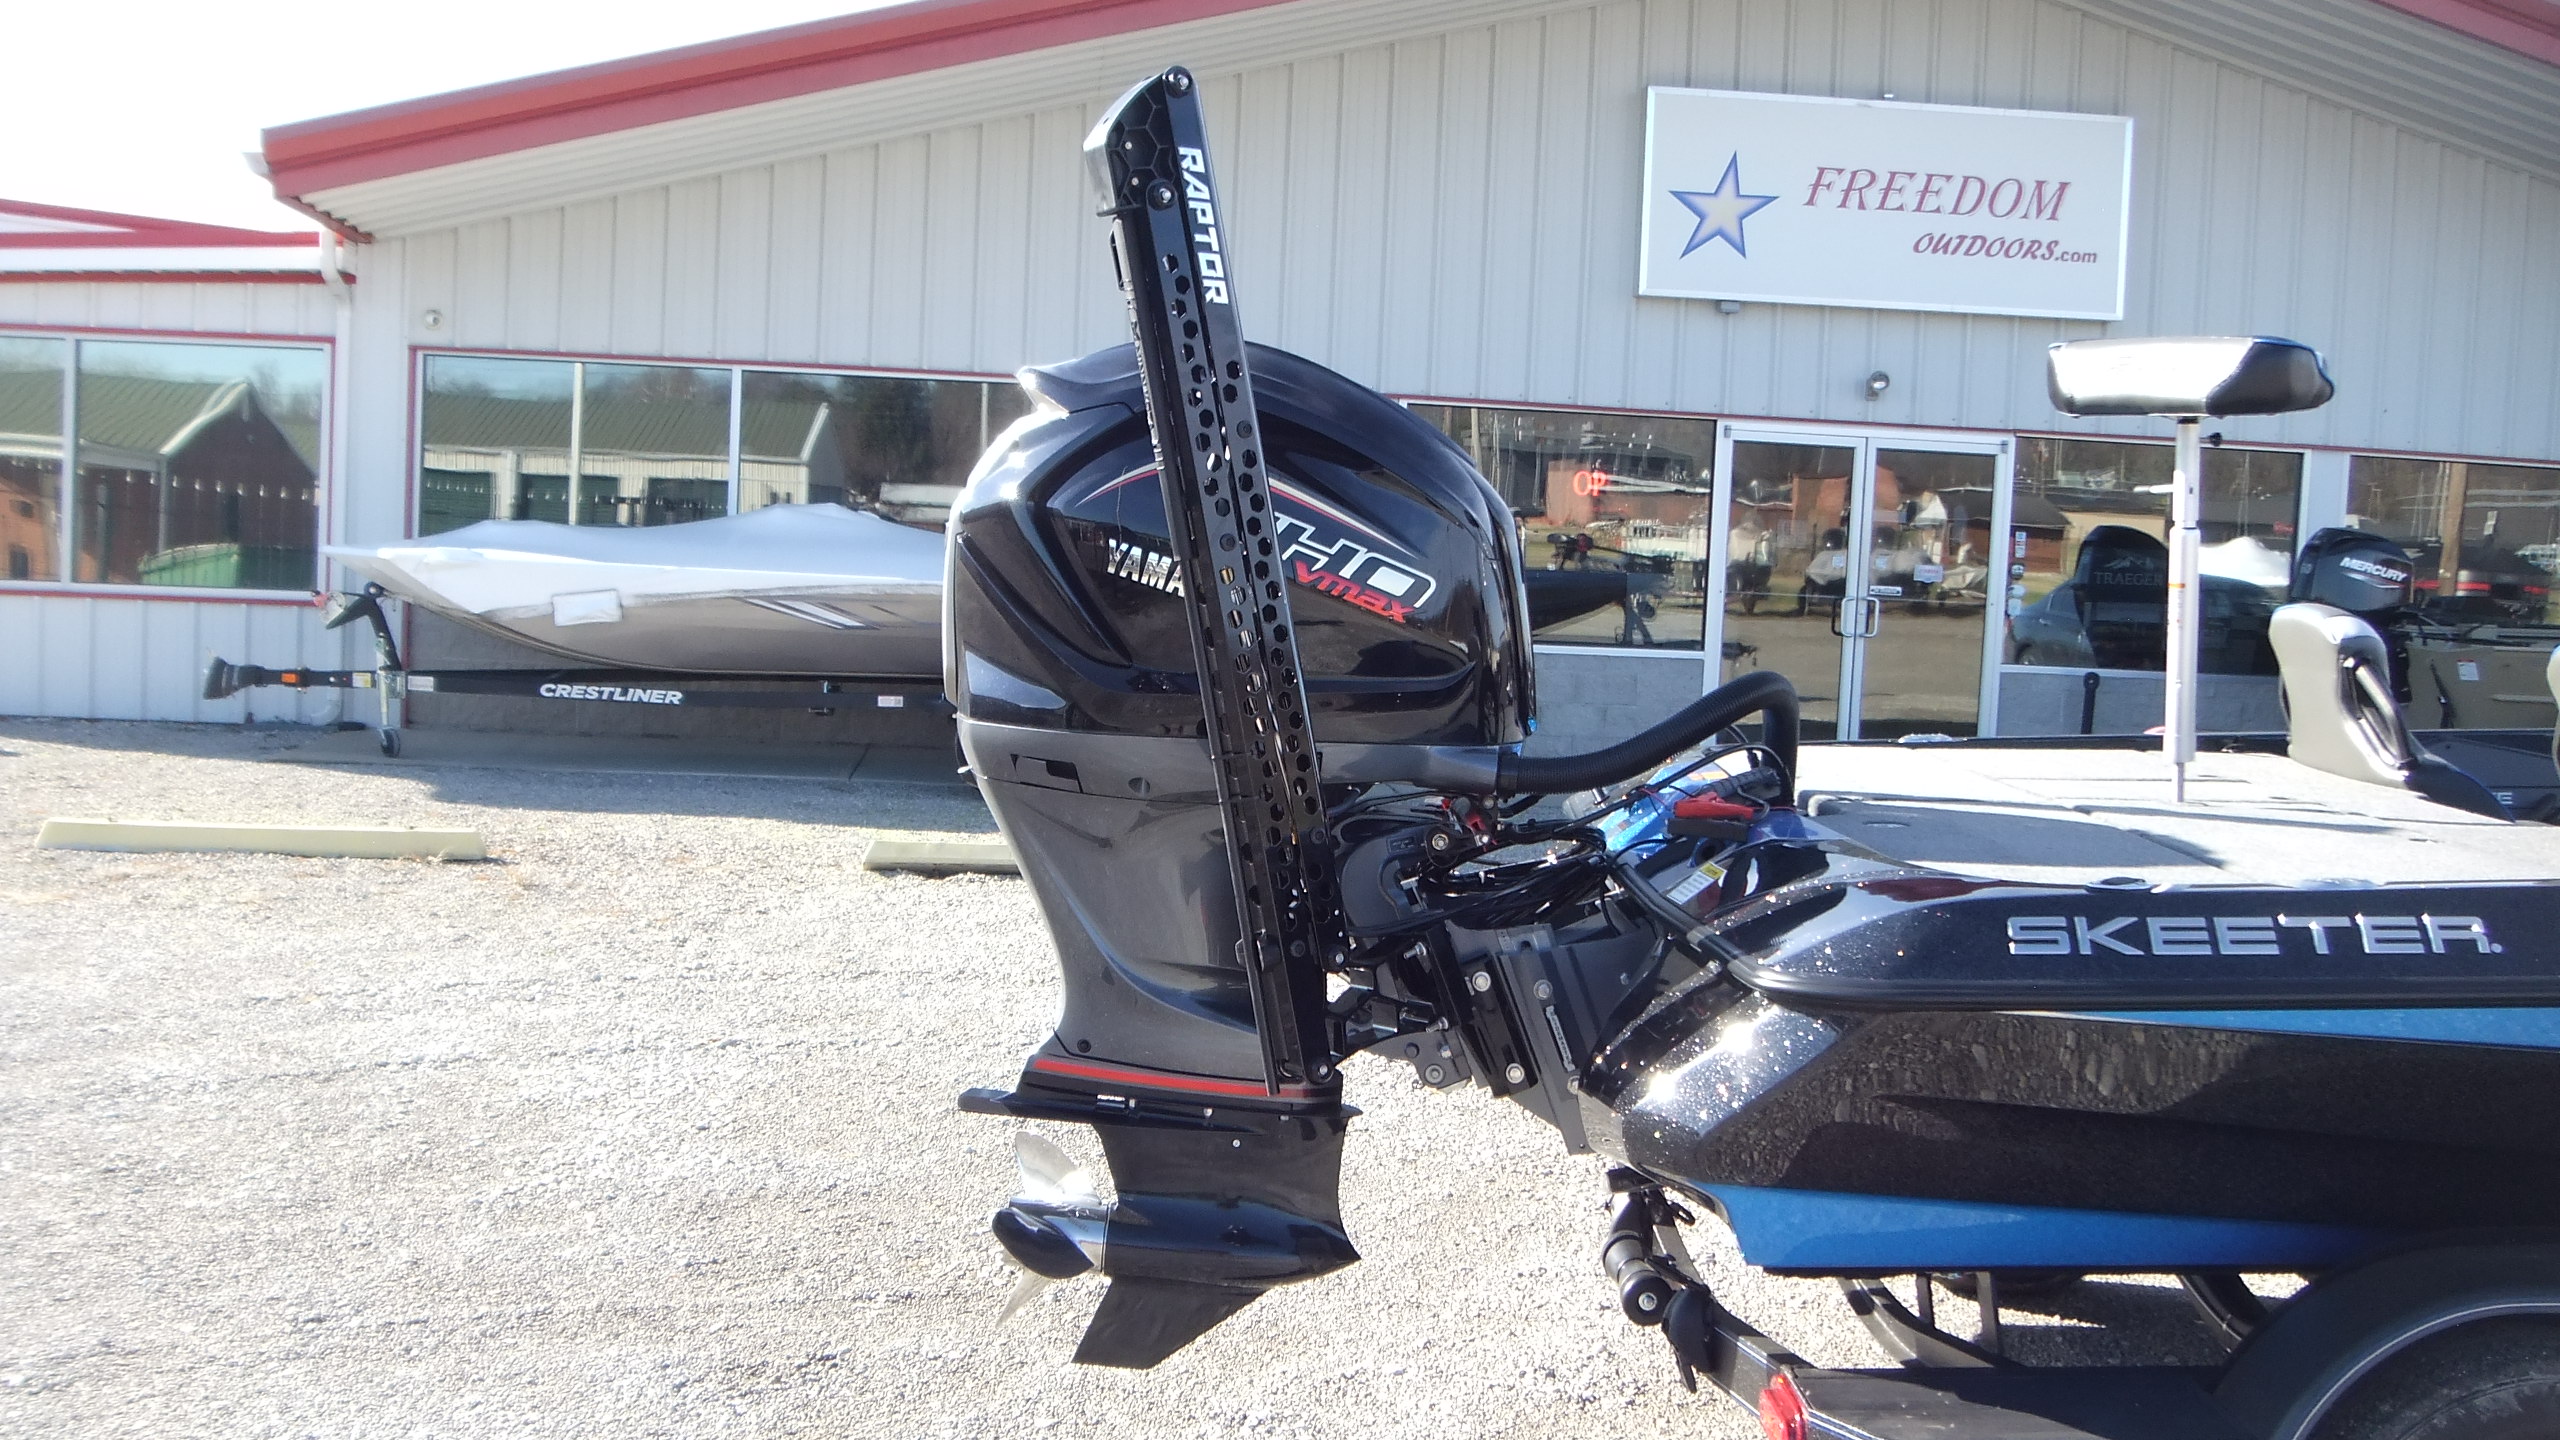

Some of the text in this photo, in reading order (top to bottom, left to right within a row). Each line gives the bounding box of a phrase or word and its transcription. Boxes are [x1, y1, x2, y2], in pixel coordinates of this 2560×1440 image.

[1802, 166, 2072, 221] FREEDOM
[1178, 147, 1229, 304] RAPTOR
[1912, 232, 2098, 264] OUTDOORS.com
[2094, 571, 2166, 586] TRAEGER
[2340, 557, 2408, 582] MERCURY
[539, 683, 684, 705] CRESTLINER
